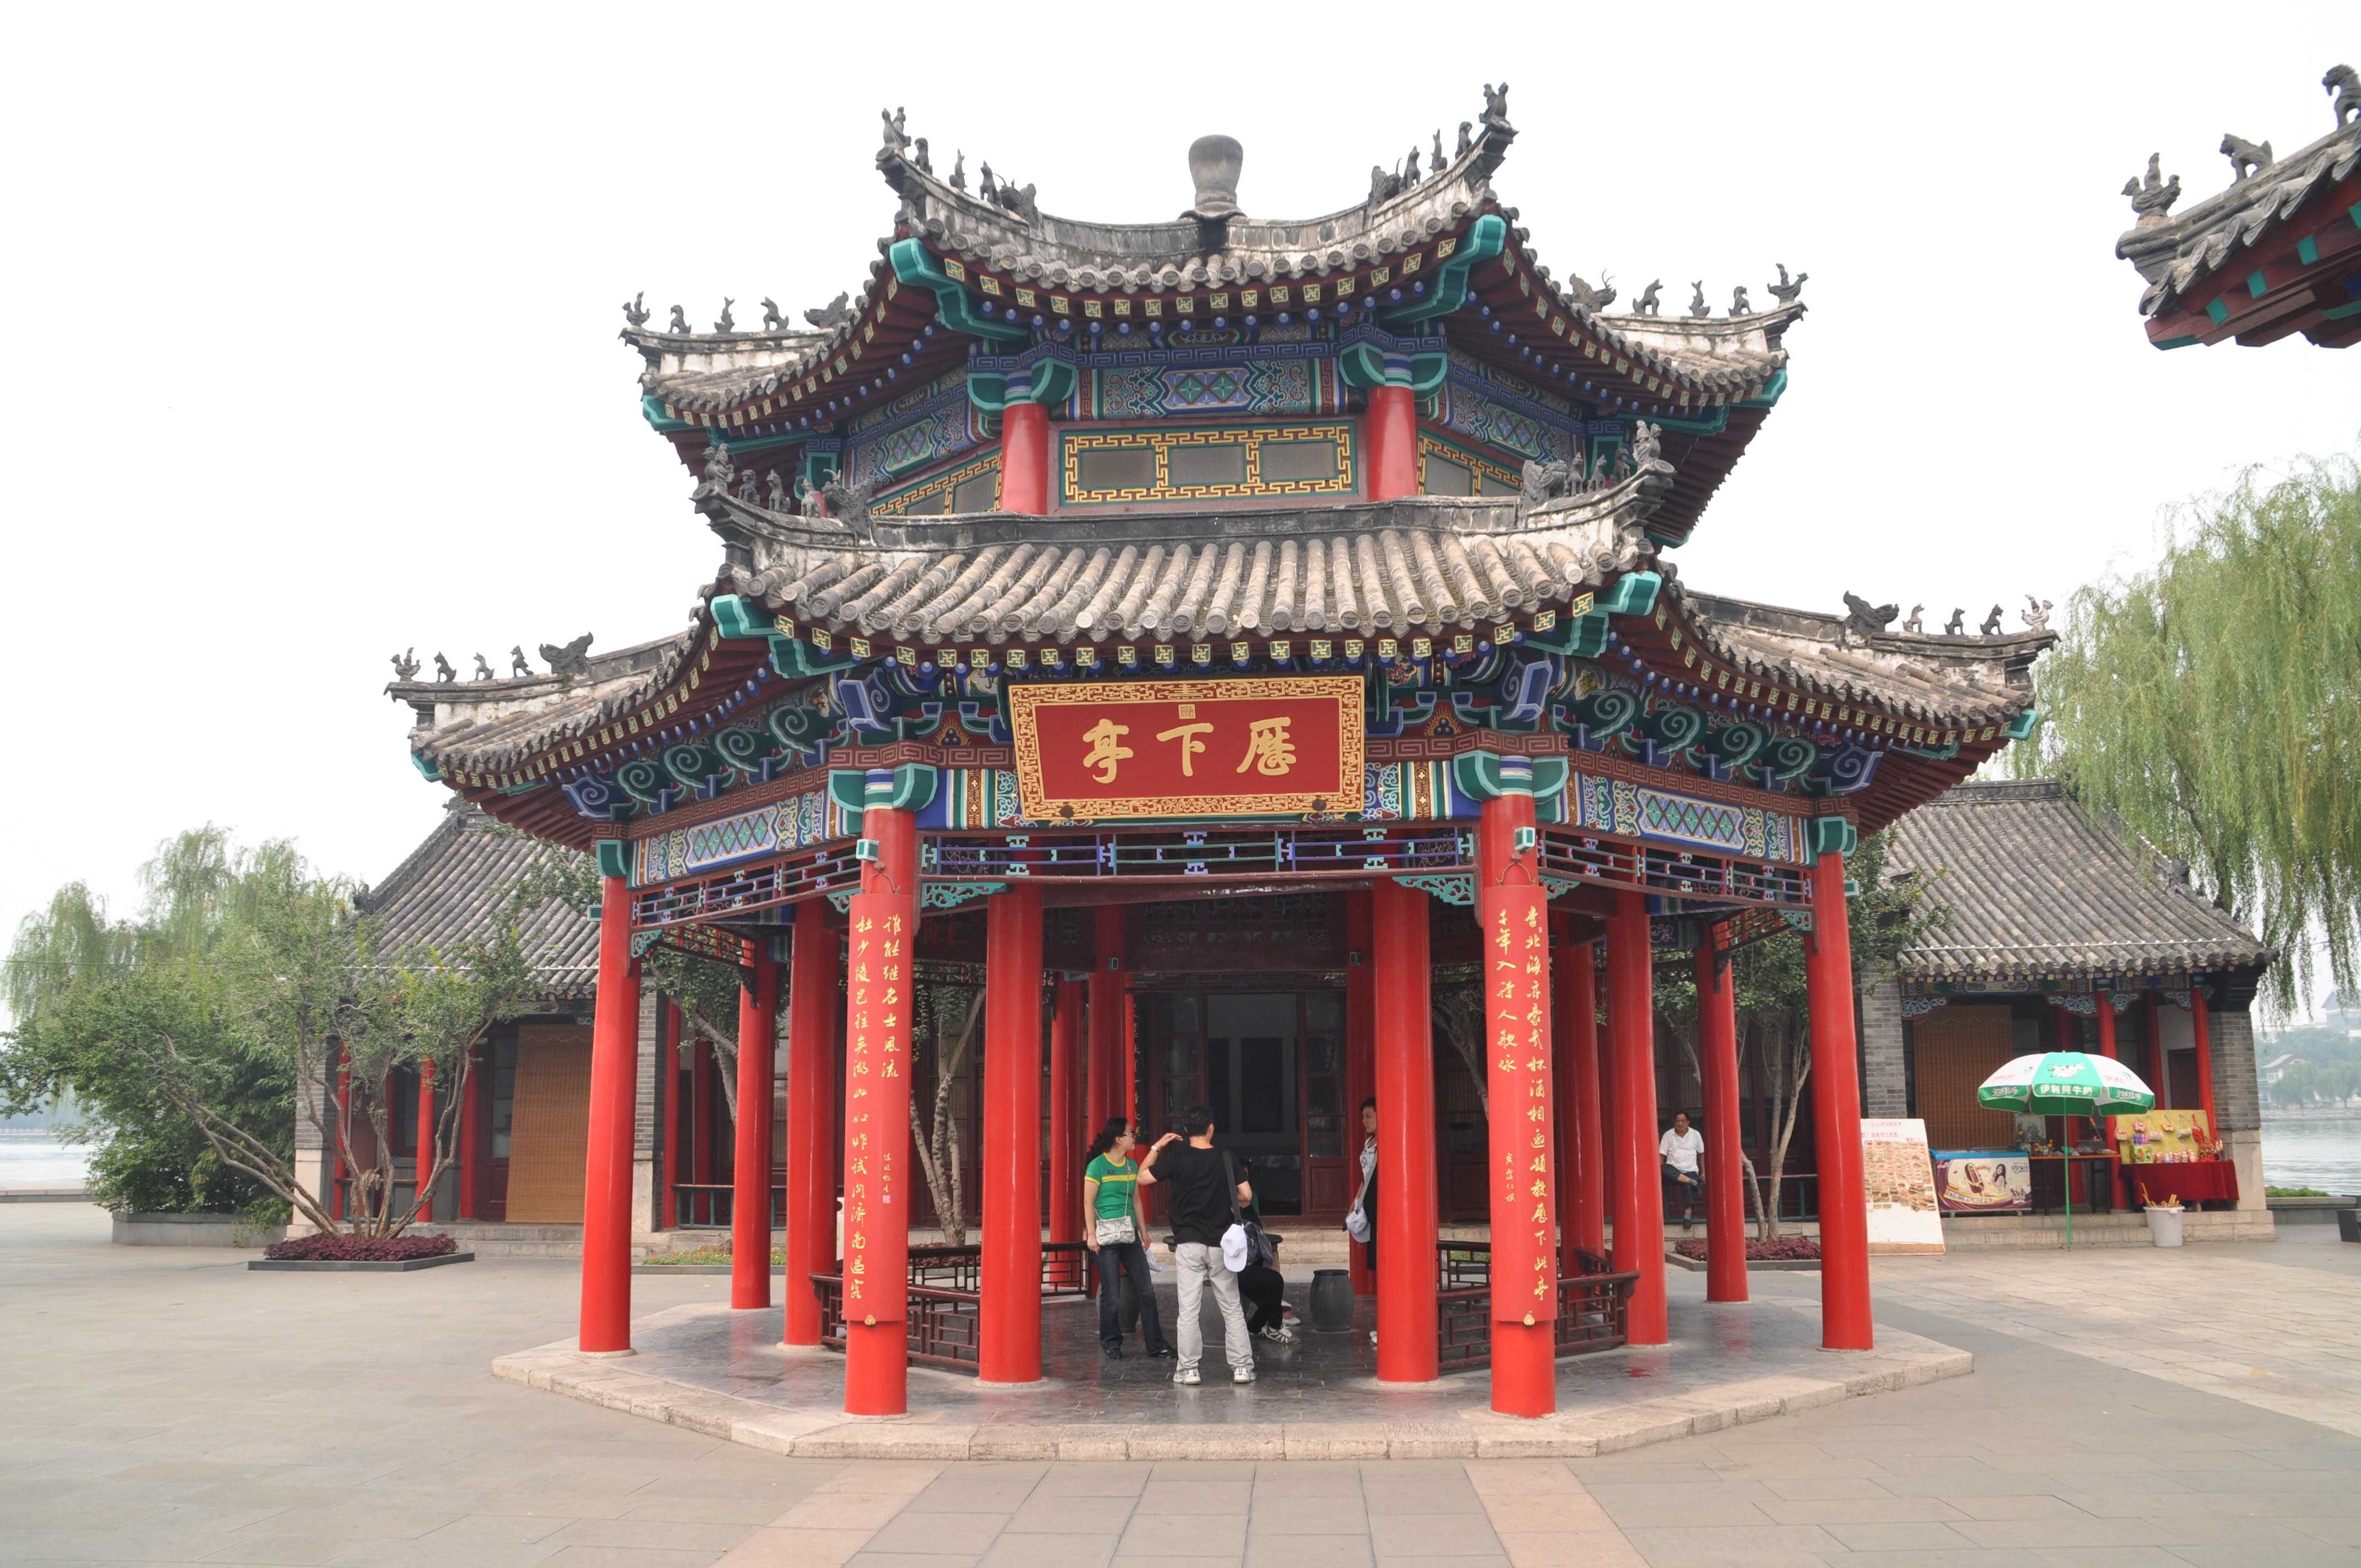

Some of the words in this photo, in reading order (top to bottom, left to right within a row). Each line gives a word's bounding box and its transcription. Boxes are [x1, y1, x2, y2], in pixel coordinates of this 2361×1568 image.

[2039, 1084, 2093, 1096] 伊利纯牛奶
